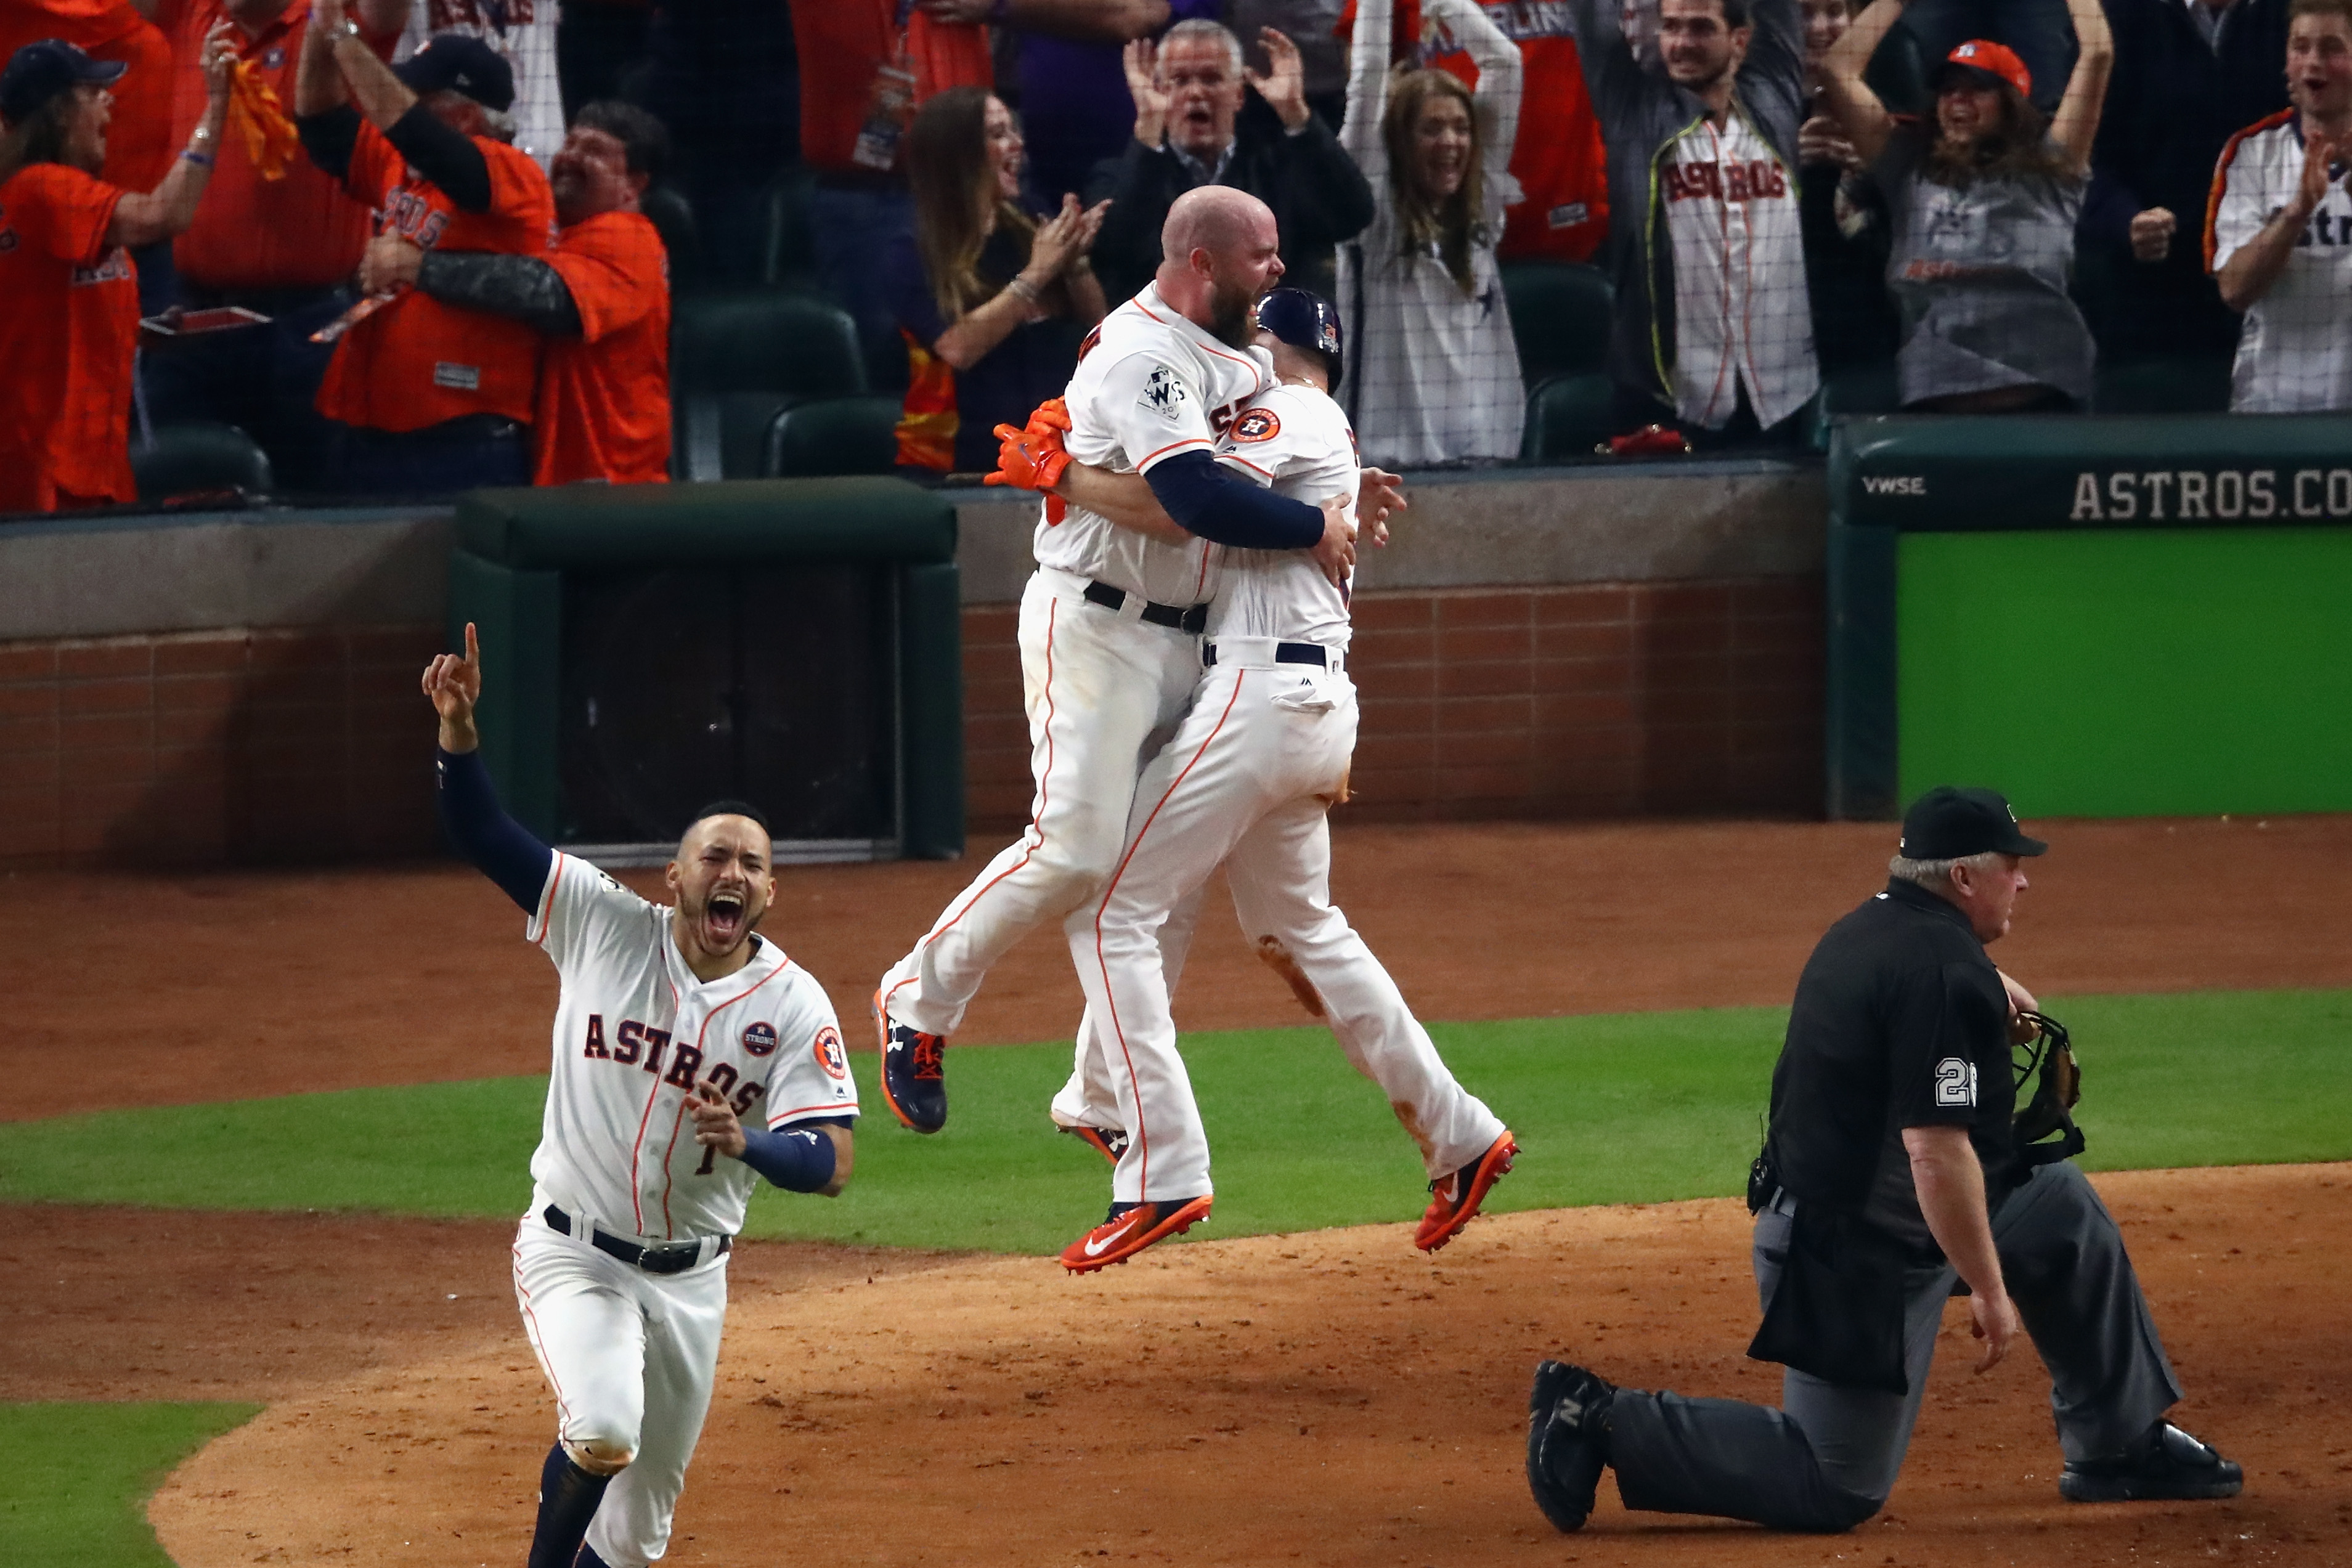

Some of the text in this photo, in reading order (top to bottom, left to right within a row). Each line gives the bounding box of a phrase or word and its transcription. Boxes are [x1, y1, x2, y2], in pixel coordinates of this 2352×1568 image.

[1862, 477, 1926, 494] VWSE
[2070, 469, 2352, 521] ASTROS.CO
[744, 1033, 775, 1046] STRONG
[584, 1014, 765, 1117] ASTROS
